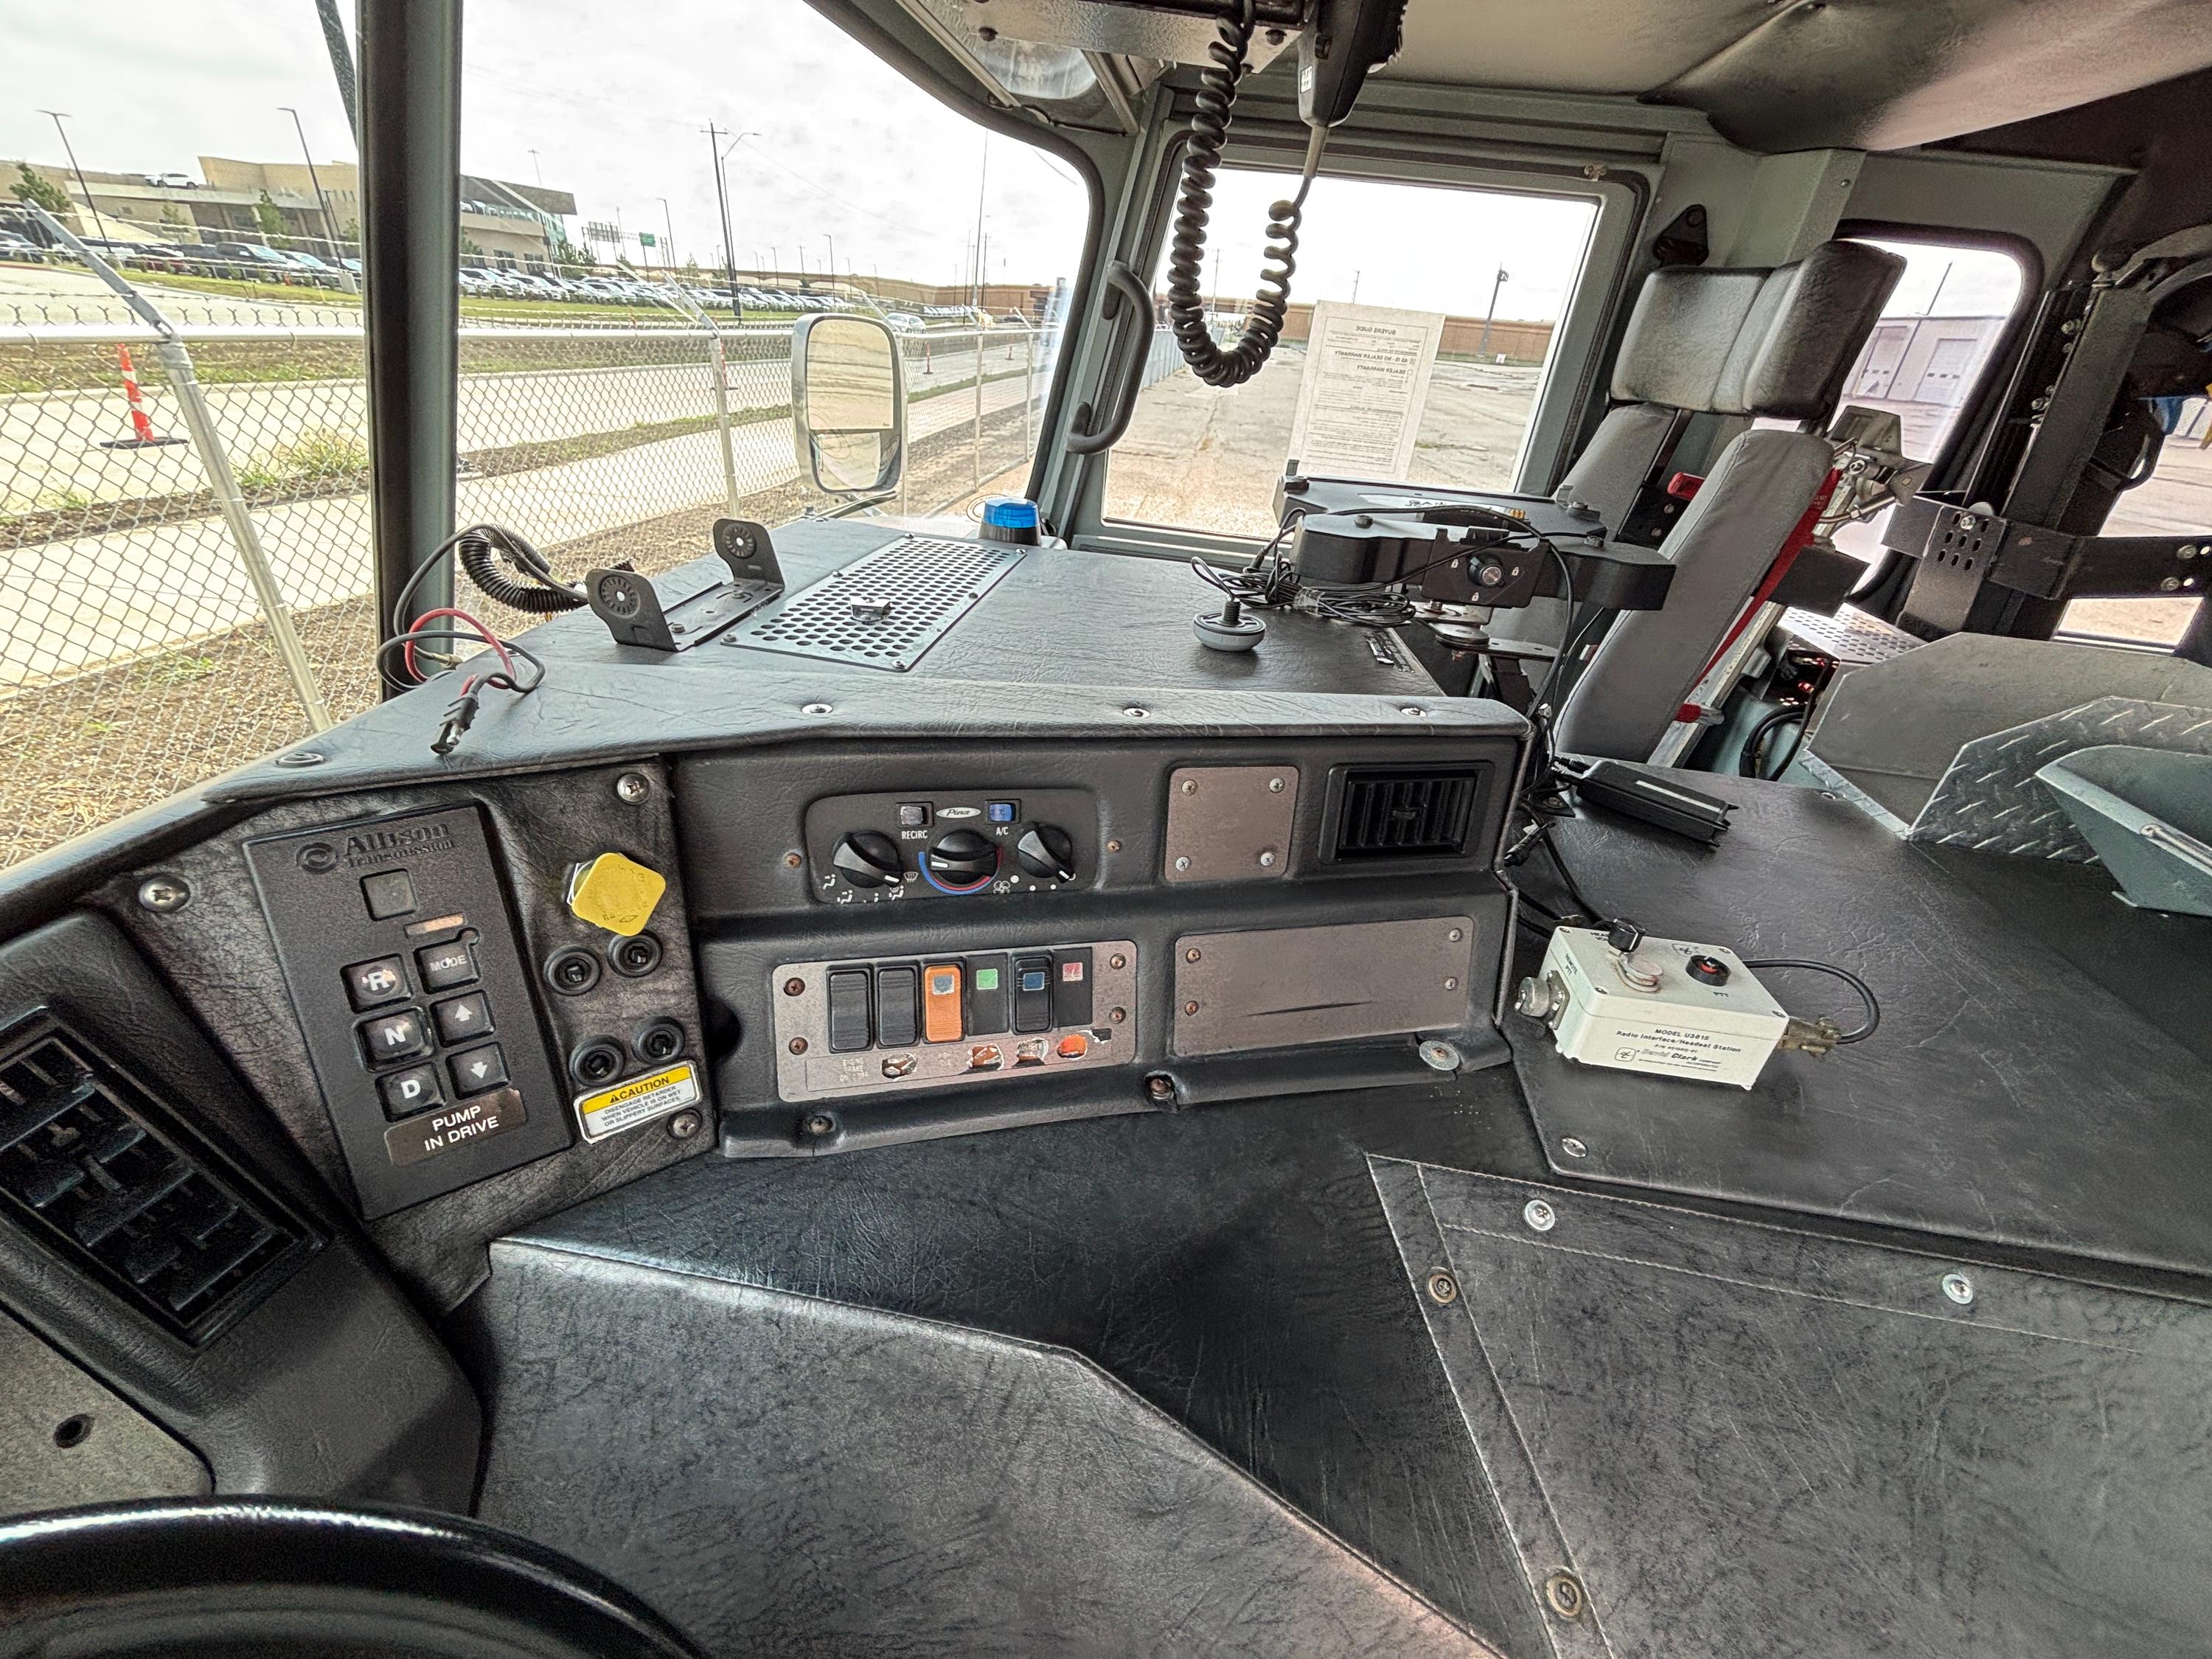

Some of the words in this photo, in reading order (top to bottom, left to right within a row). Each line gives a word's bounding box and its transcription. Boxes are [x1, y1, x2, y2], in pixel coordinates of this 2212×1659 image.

[947, 808, 970, 816] Pierce
[346, 824, 452, 856] Allison
[901, 830, 928, 840] RECIRC
[996, 827, 1009, 836] A/C
[430, 955, 467, 972] MODE
[367, 971, 390, 991] R
[383, 1026, 406, 1046] N
[1655, 1029, 1682, 1037] MODEL
[1671, 1053, 1699, 1061] Clark
[1713, 1044, 1742, 1053] Station
[400, 1079, 420, 1099] D
[619, 1076, 669, 1099] CAUTION
[602, 1111, 621, 1121] WHEN
[622, 1101, 649, 1116] VEHICLE
[658, 1094, 667, 1103] ON
[667, 1090, 681, 1099] WET
[605, 1097, 641, 1115] DISENGAGE
[643, 1085, 677, 1102] RETARDER
[616, 1108, 647, 1124] SLIPPERY
[647, 1096, 681, 1112] SURFACES
[432, 1105, 481, 1132] PUMP
[424, 1135, 444, 1151] IN
[447, 1116, 500, 1144] DRIVE
